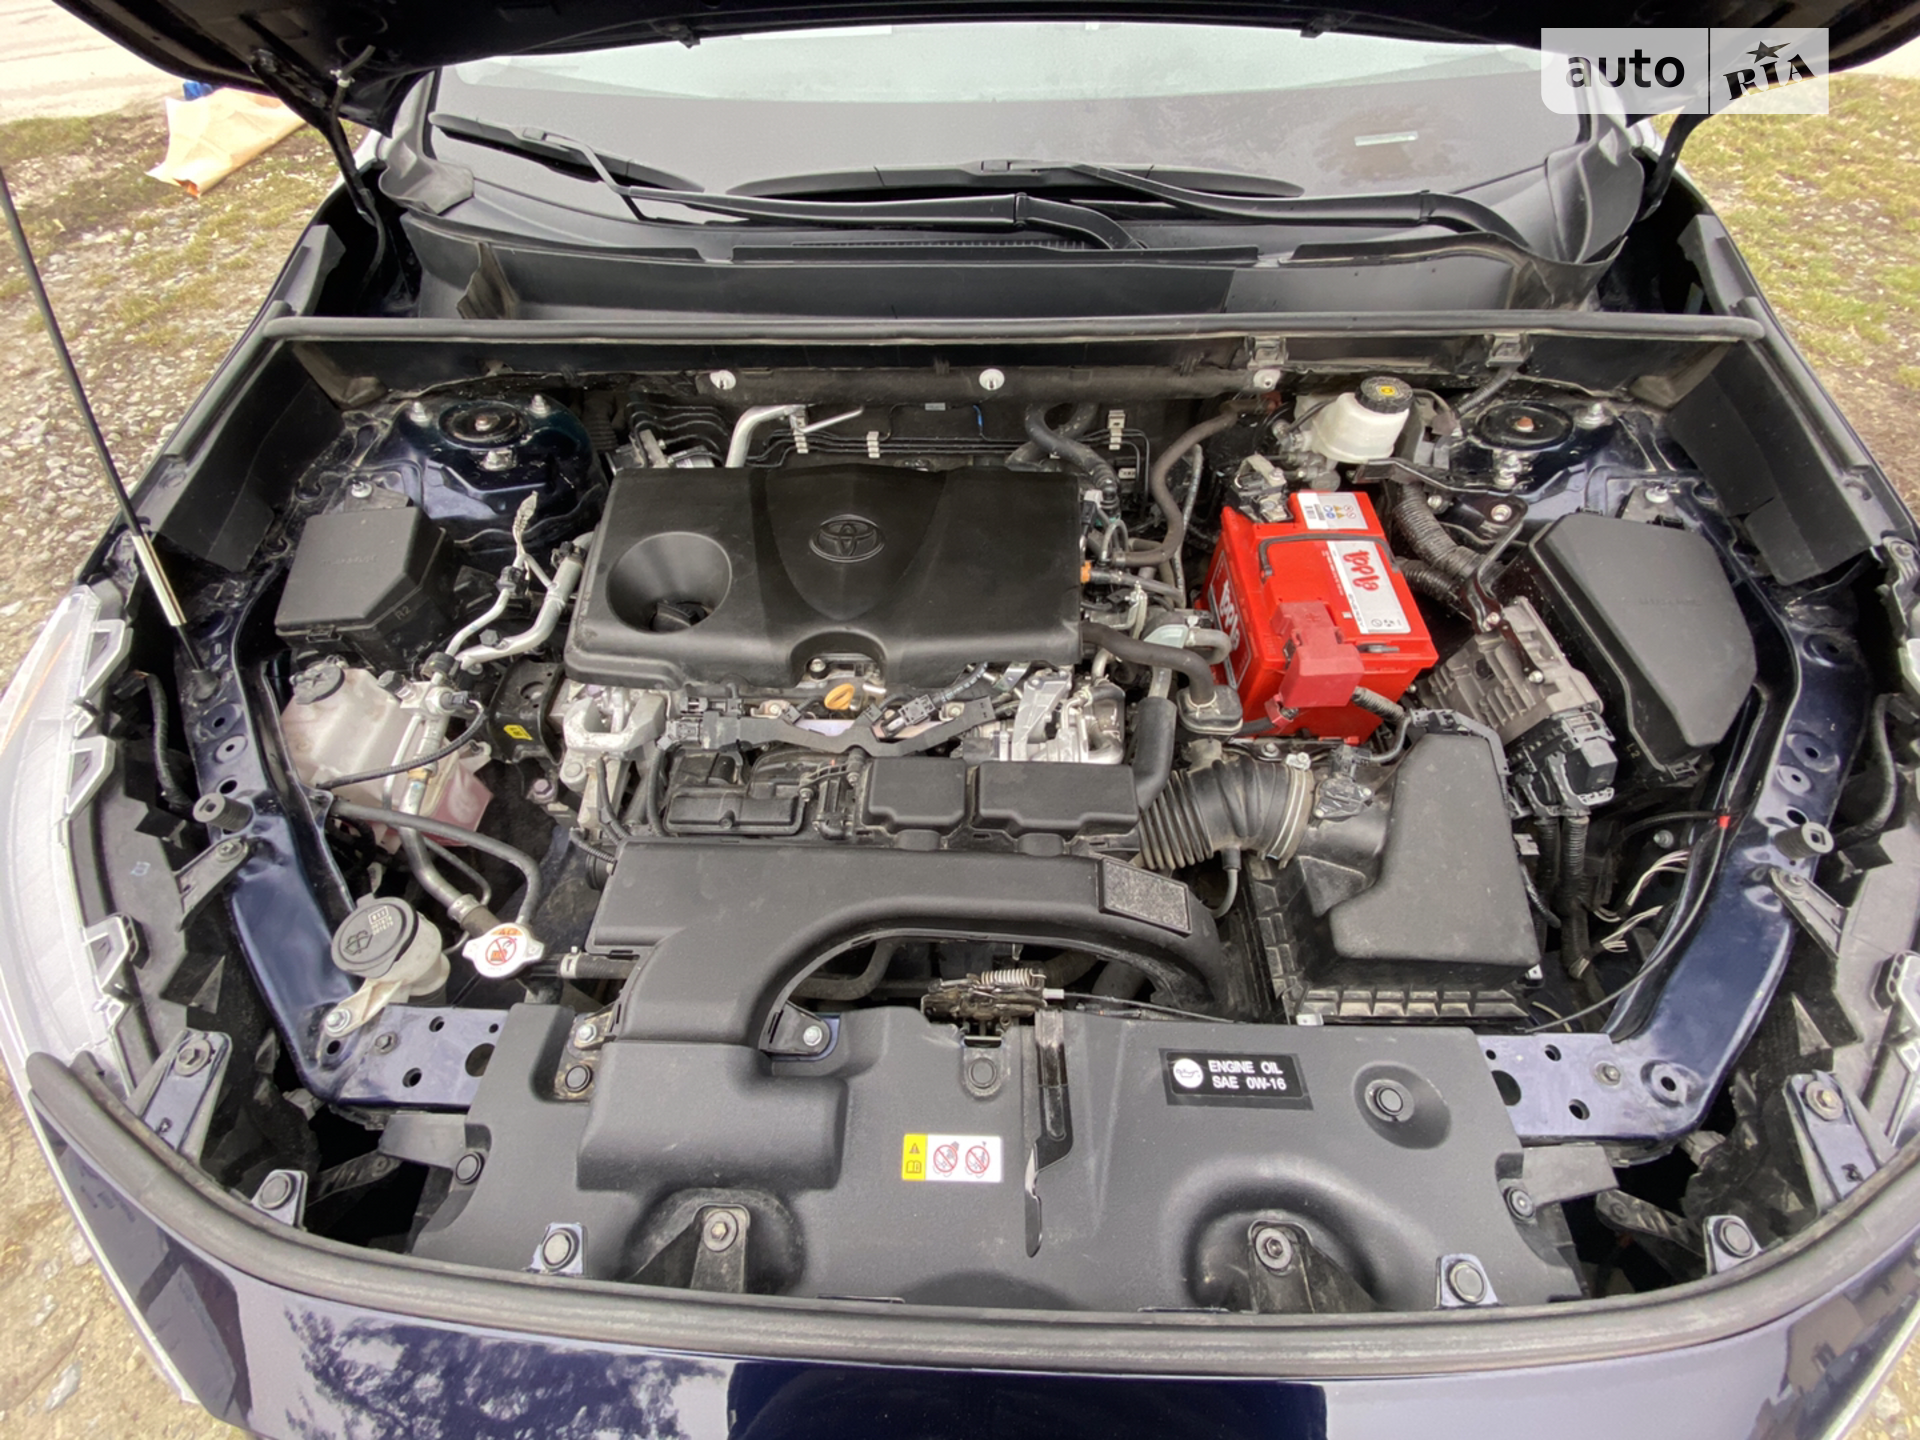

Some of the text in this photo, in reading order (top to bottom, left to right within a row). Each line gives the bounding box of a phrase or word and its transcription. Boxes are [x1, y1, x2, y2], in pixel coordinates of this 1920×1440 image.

[1207, 1059, 1284, 1075] ENGINE OIL
[1212, 1075, 1287, 1091] SAE 0W-16
